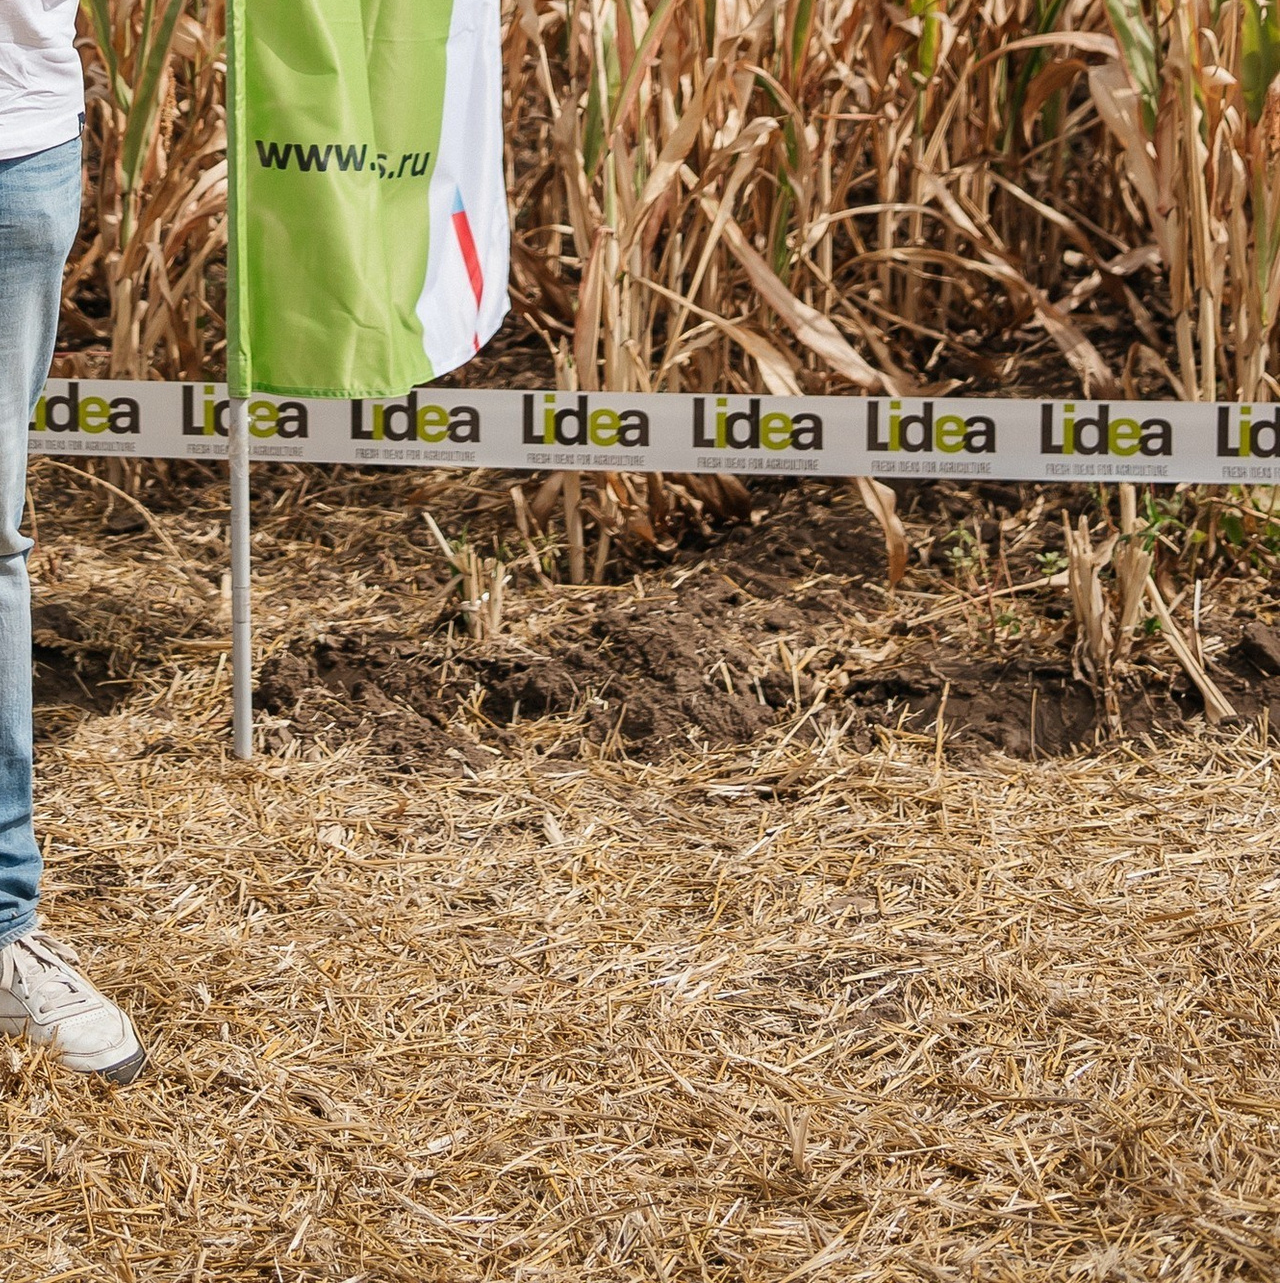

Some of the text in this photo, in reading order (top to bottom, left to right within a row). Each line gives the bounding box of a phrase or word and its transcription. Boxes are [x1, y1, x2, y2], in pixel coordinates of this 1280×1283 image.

[28, 382, 140, 434] idea
[351, 391, 480, 443] Lidea
[523, 394, 649, 447] Lidea
[694, 397, 823, 450] Lidea
[867, 400, 996, 453] Lidea
[1041, 403, 1172, 456] Lidea
[1217, 406, 1280, 458] Lid
